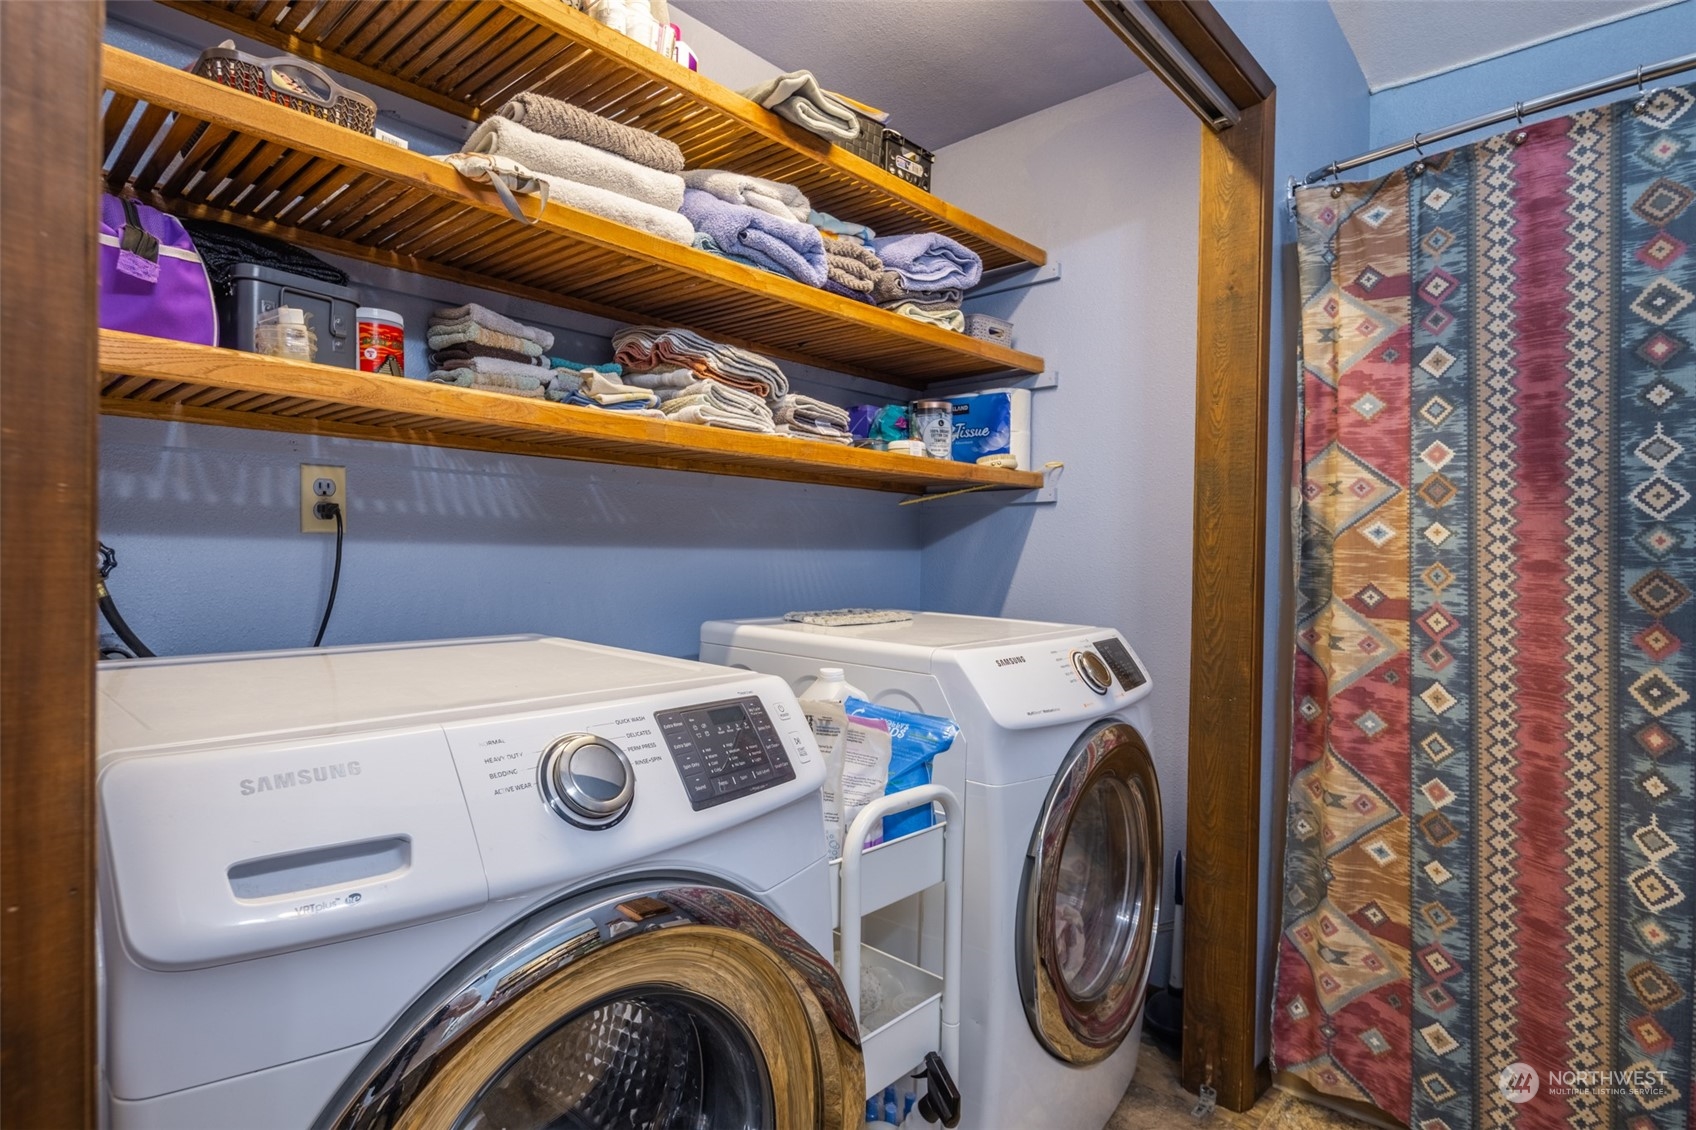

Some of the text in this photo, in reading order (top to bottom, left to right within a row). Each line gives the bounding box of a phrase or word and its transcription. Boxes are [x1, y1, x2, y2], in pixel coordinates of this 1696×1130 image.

[956, 423, 990, 438] Tissue
[996, 656, 1026, 667] SAMSUNG
[626, 729, 651, 738] DELICATES
[635, 756, 662, 765] RINSE+SPIN
[240, 761, 362, 796] SAMSUNG
[489, 769, 518, 779] BEDDING
[515, 783, 532, 791] WEAR
